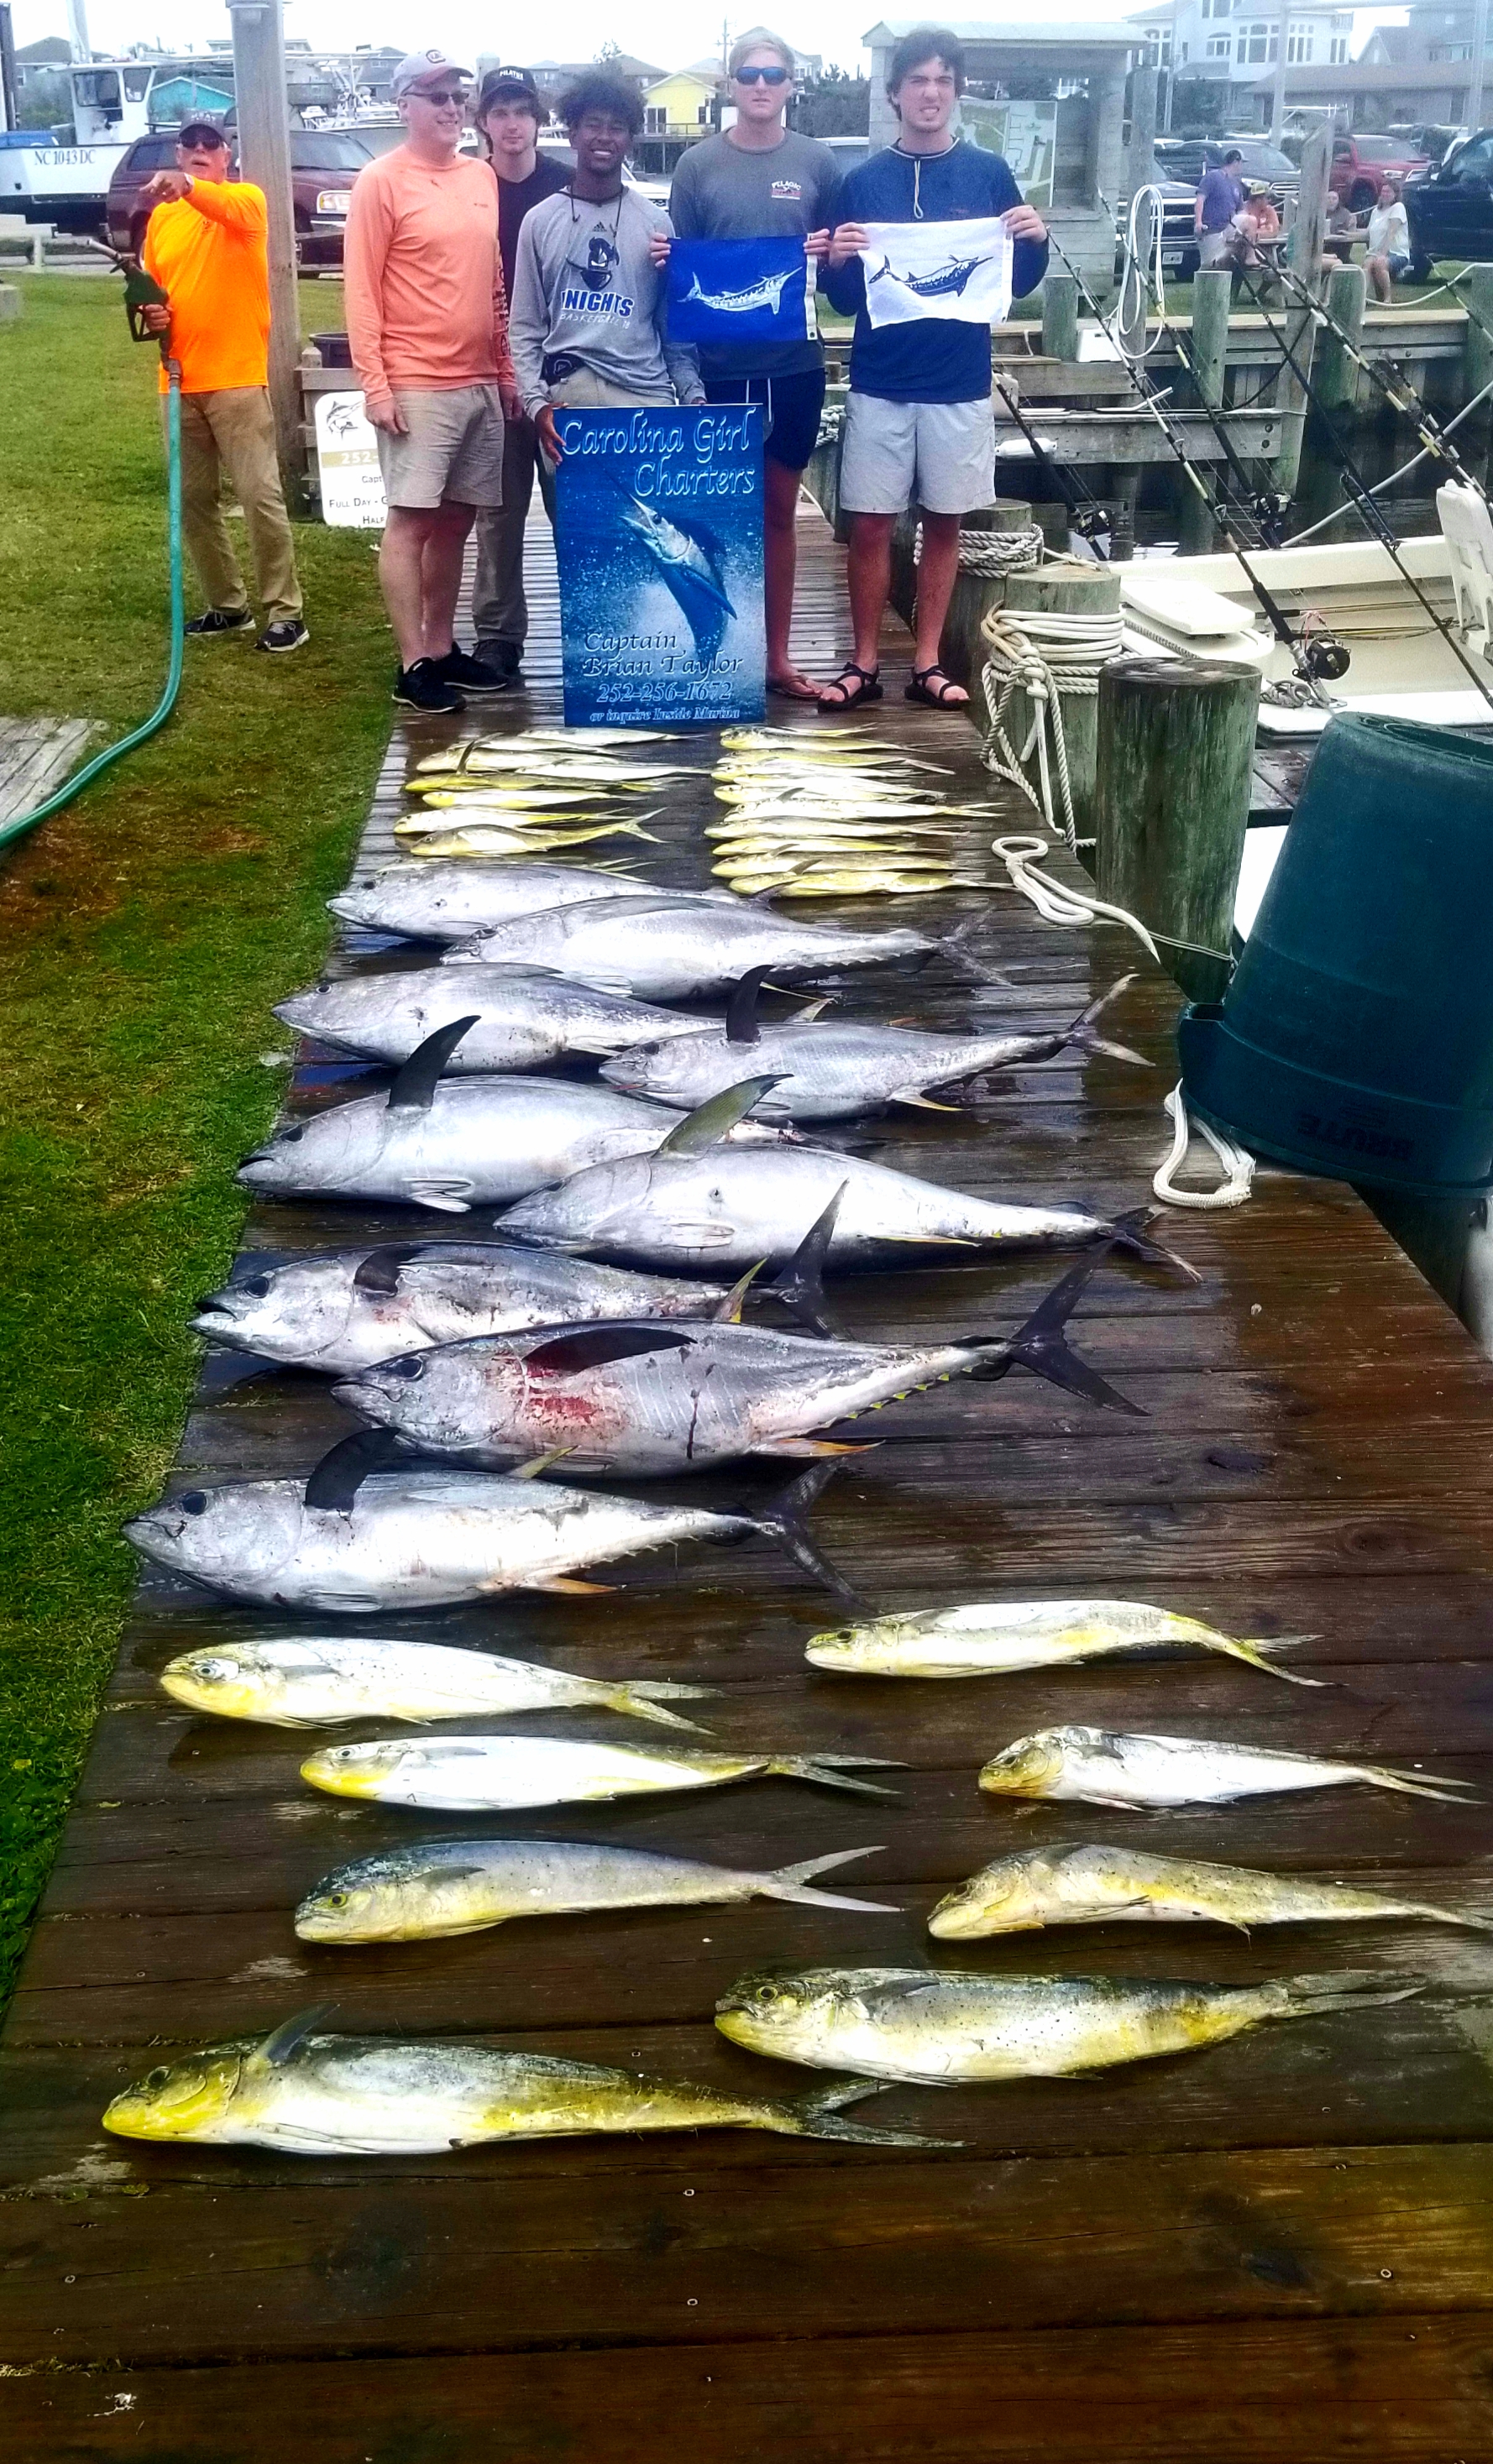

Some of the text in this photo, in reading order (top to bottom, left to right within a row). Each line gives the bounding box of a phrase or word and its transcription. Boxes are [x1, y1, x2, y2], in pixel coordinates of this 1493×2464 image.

[34, 149, 97, 165] NC 1043 DC
[562, 405, 757, 463] Carolina Girl
[634, 453, 756, 497] Charters
[584, 630, 678, 661] Captain
[582, 649, 744, 684] Brian Taylor
[596, 681, 733, 703] 252-256-1672
[589, 705, 741, 724] or inquire Inside Marina
